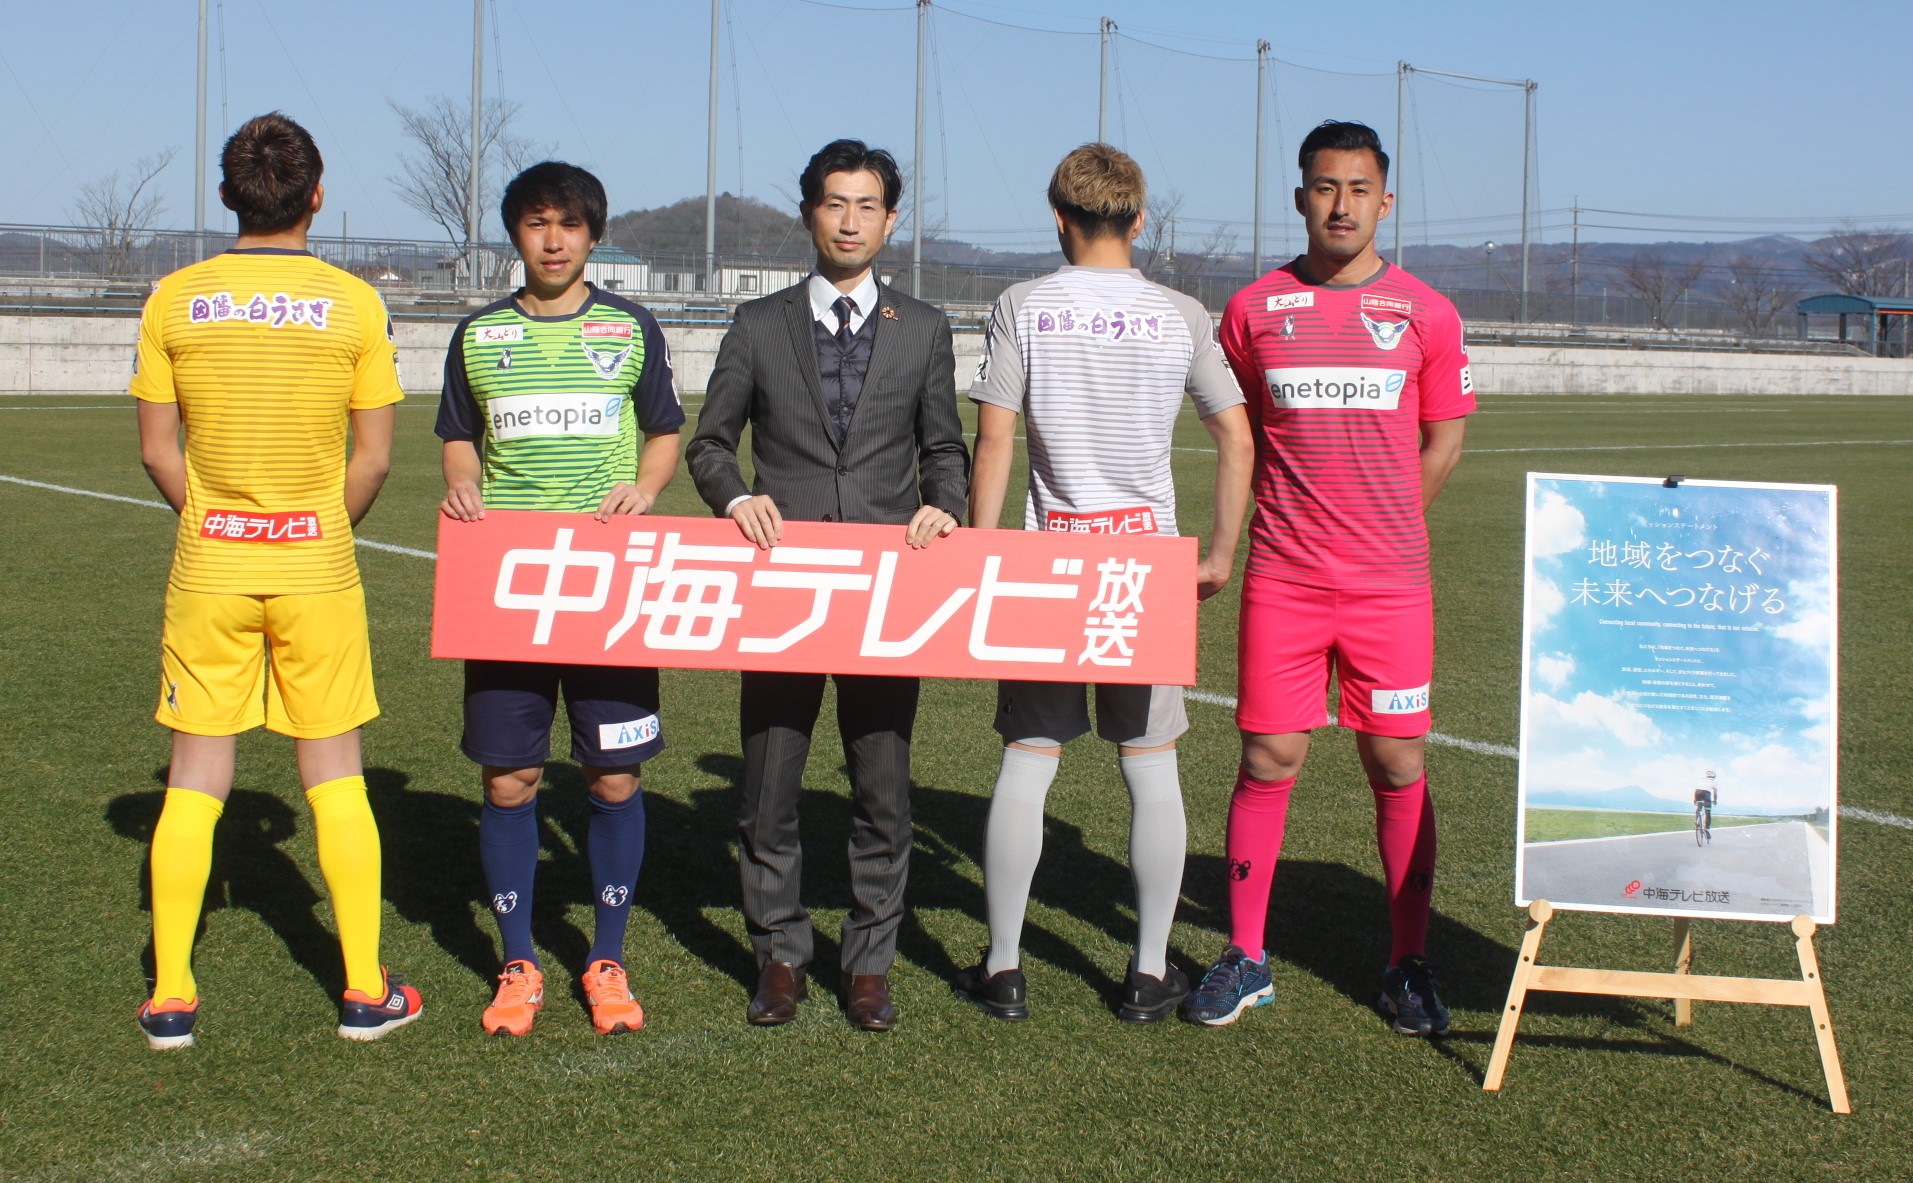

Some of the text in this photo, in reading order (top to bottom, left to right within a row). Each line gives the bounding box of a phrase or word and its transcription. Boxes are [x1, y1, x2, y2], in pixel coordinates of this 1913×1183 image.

[1270, 376, 1381, 406] enetopia
[493, 401, 601, 431] enetopia
[1588, 539, 1770, 576] 地域をつなぐ
[1570, 577, 1785, 615] 未来へつなげる
[1643, 887, 1730, 904] 中海テレビ放送
